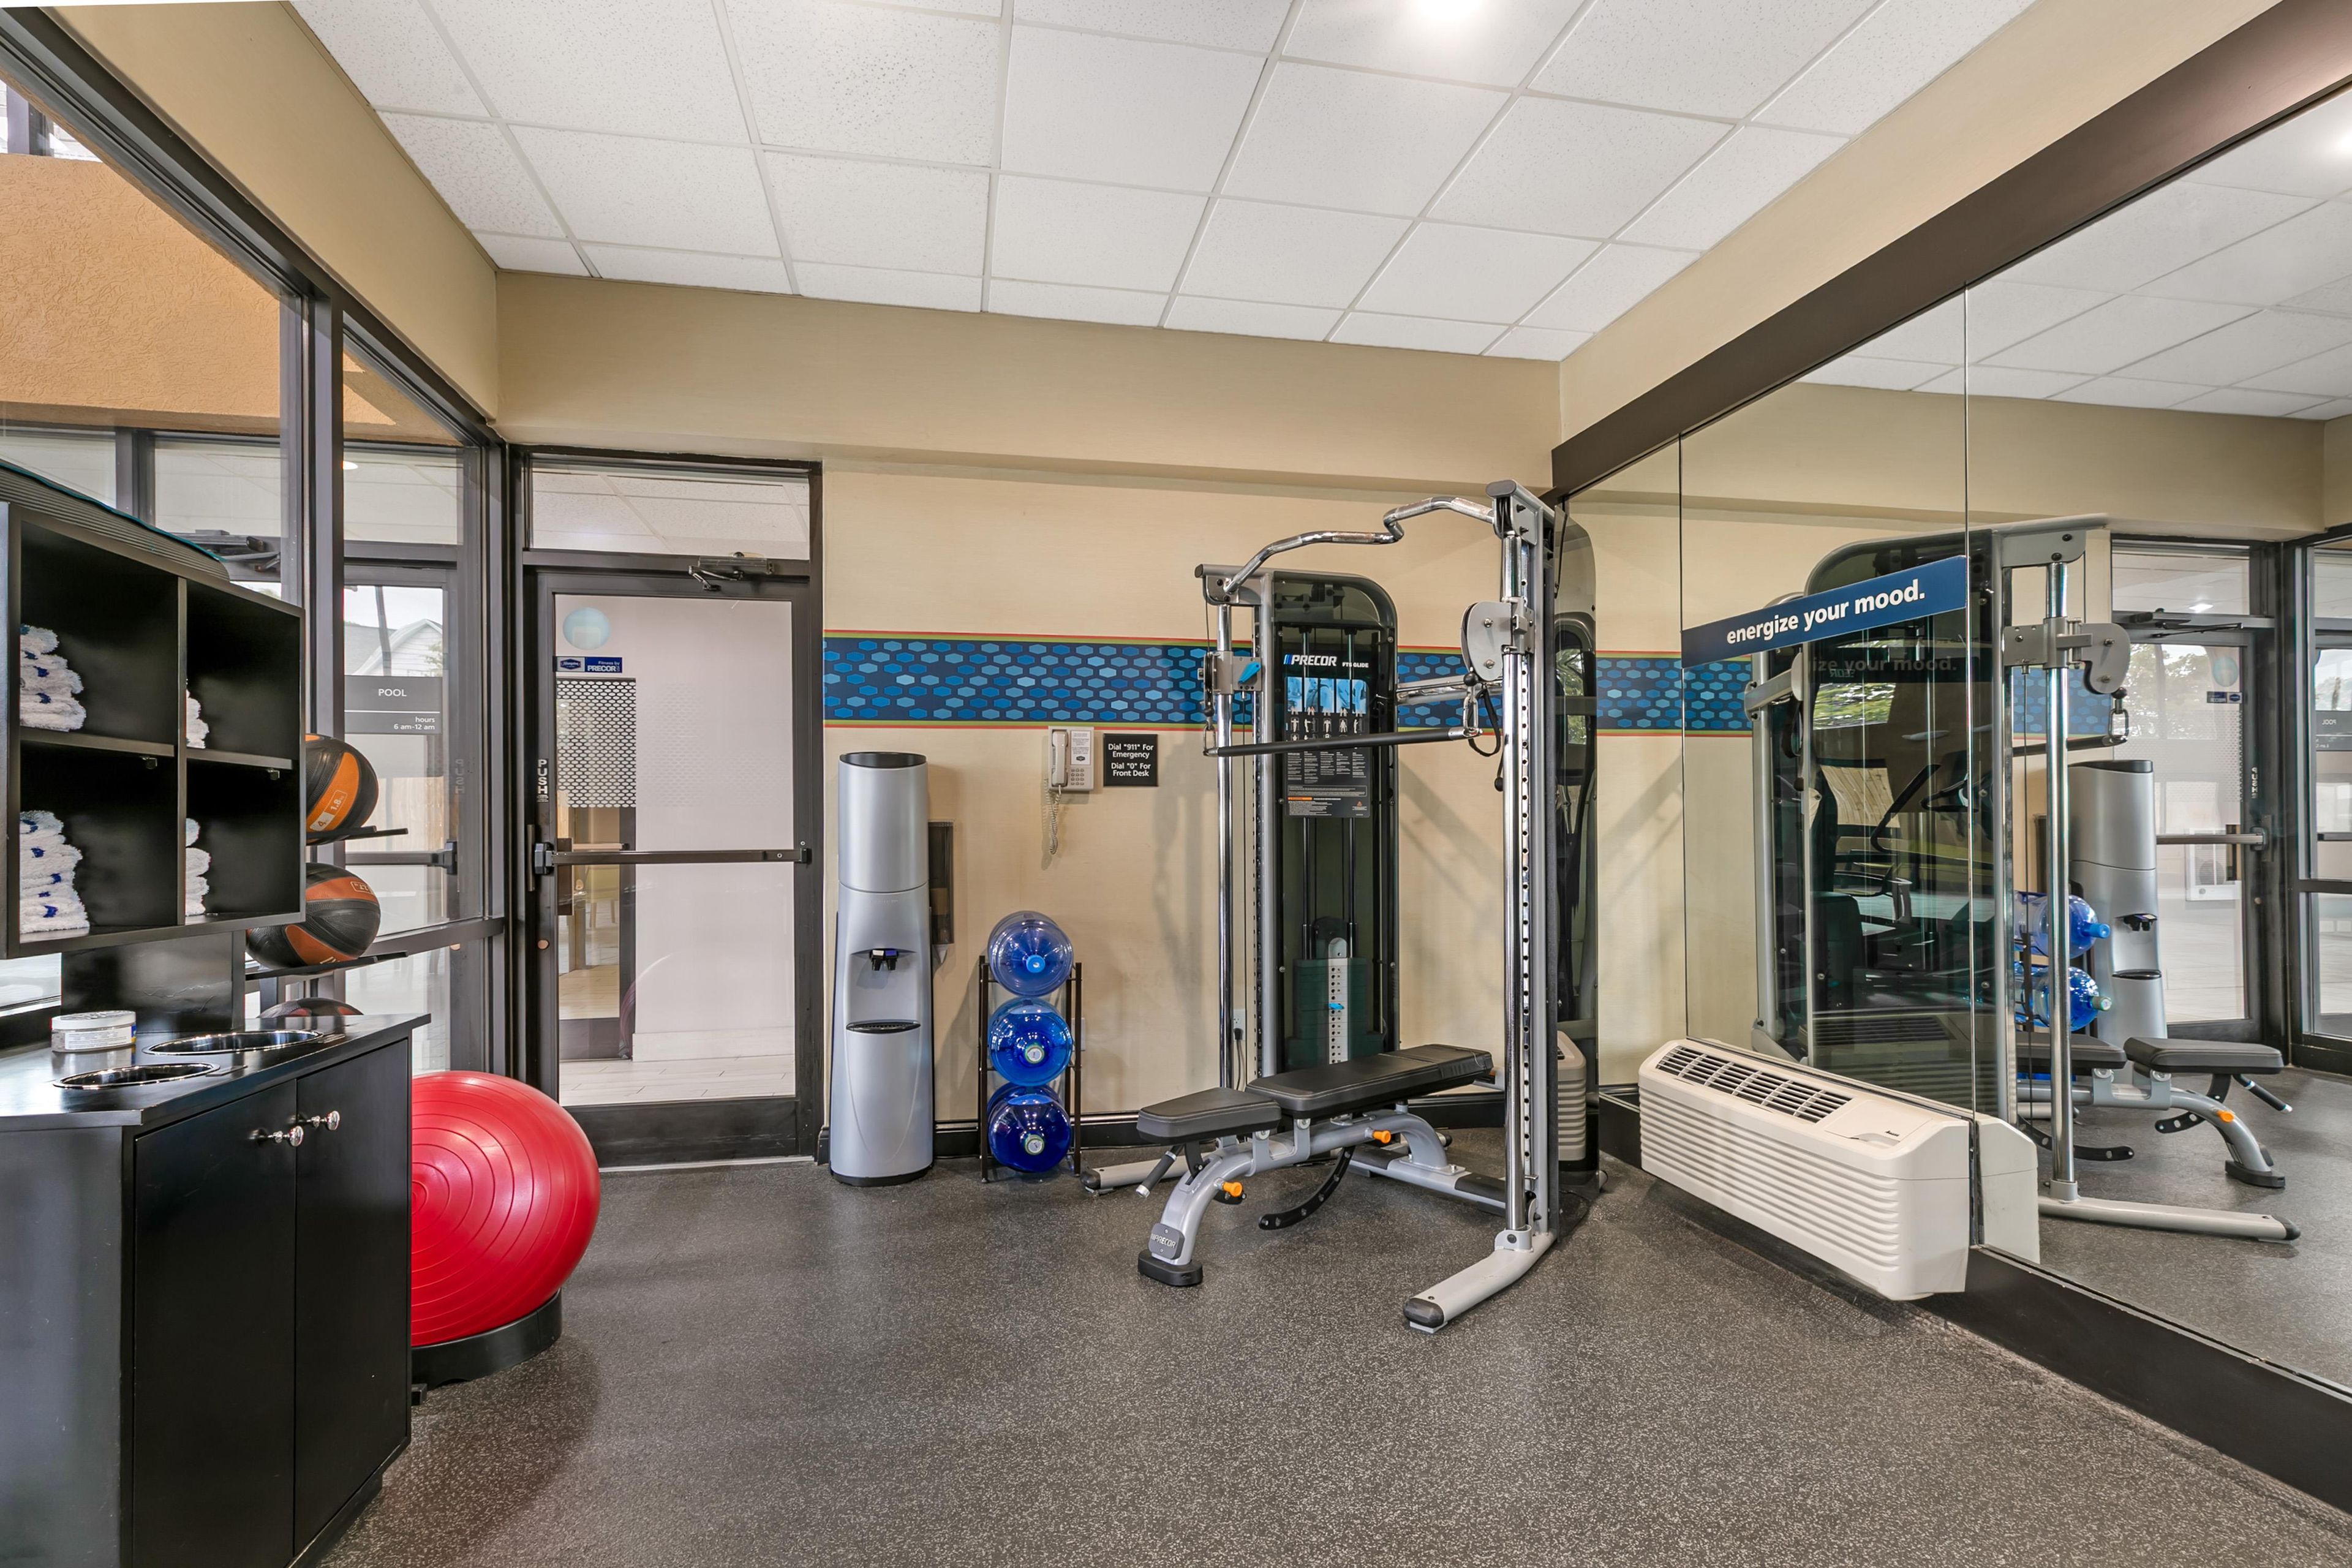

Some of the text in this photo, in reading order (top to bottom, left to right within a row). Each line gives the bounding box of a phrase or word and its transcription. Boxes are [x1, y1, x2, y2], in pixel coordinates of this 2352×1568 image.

[1727, 579, 1924, 644] energize your mood.
[1291, 654, 1337, 666] PRECOR
[537, 760, 548, 794] PUSH
[1155, 1234, 1177, 1248] PRECOR
